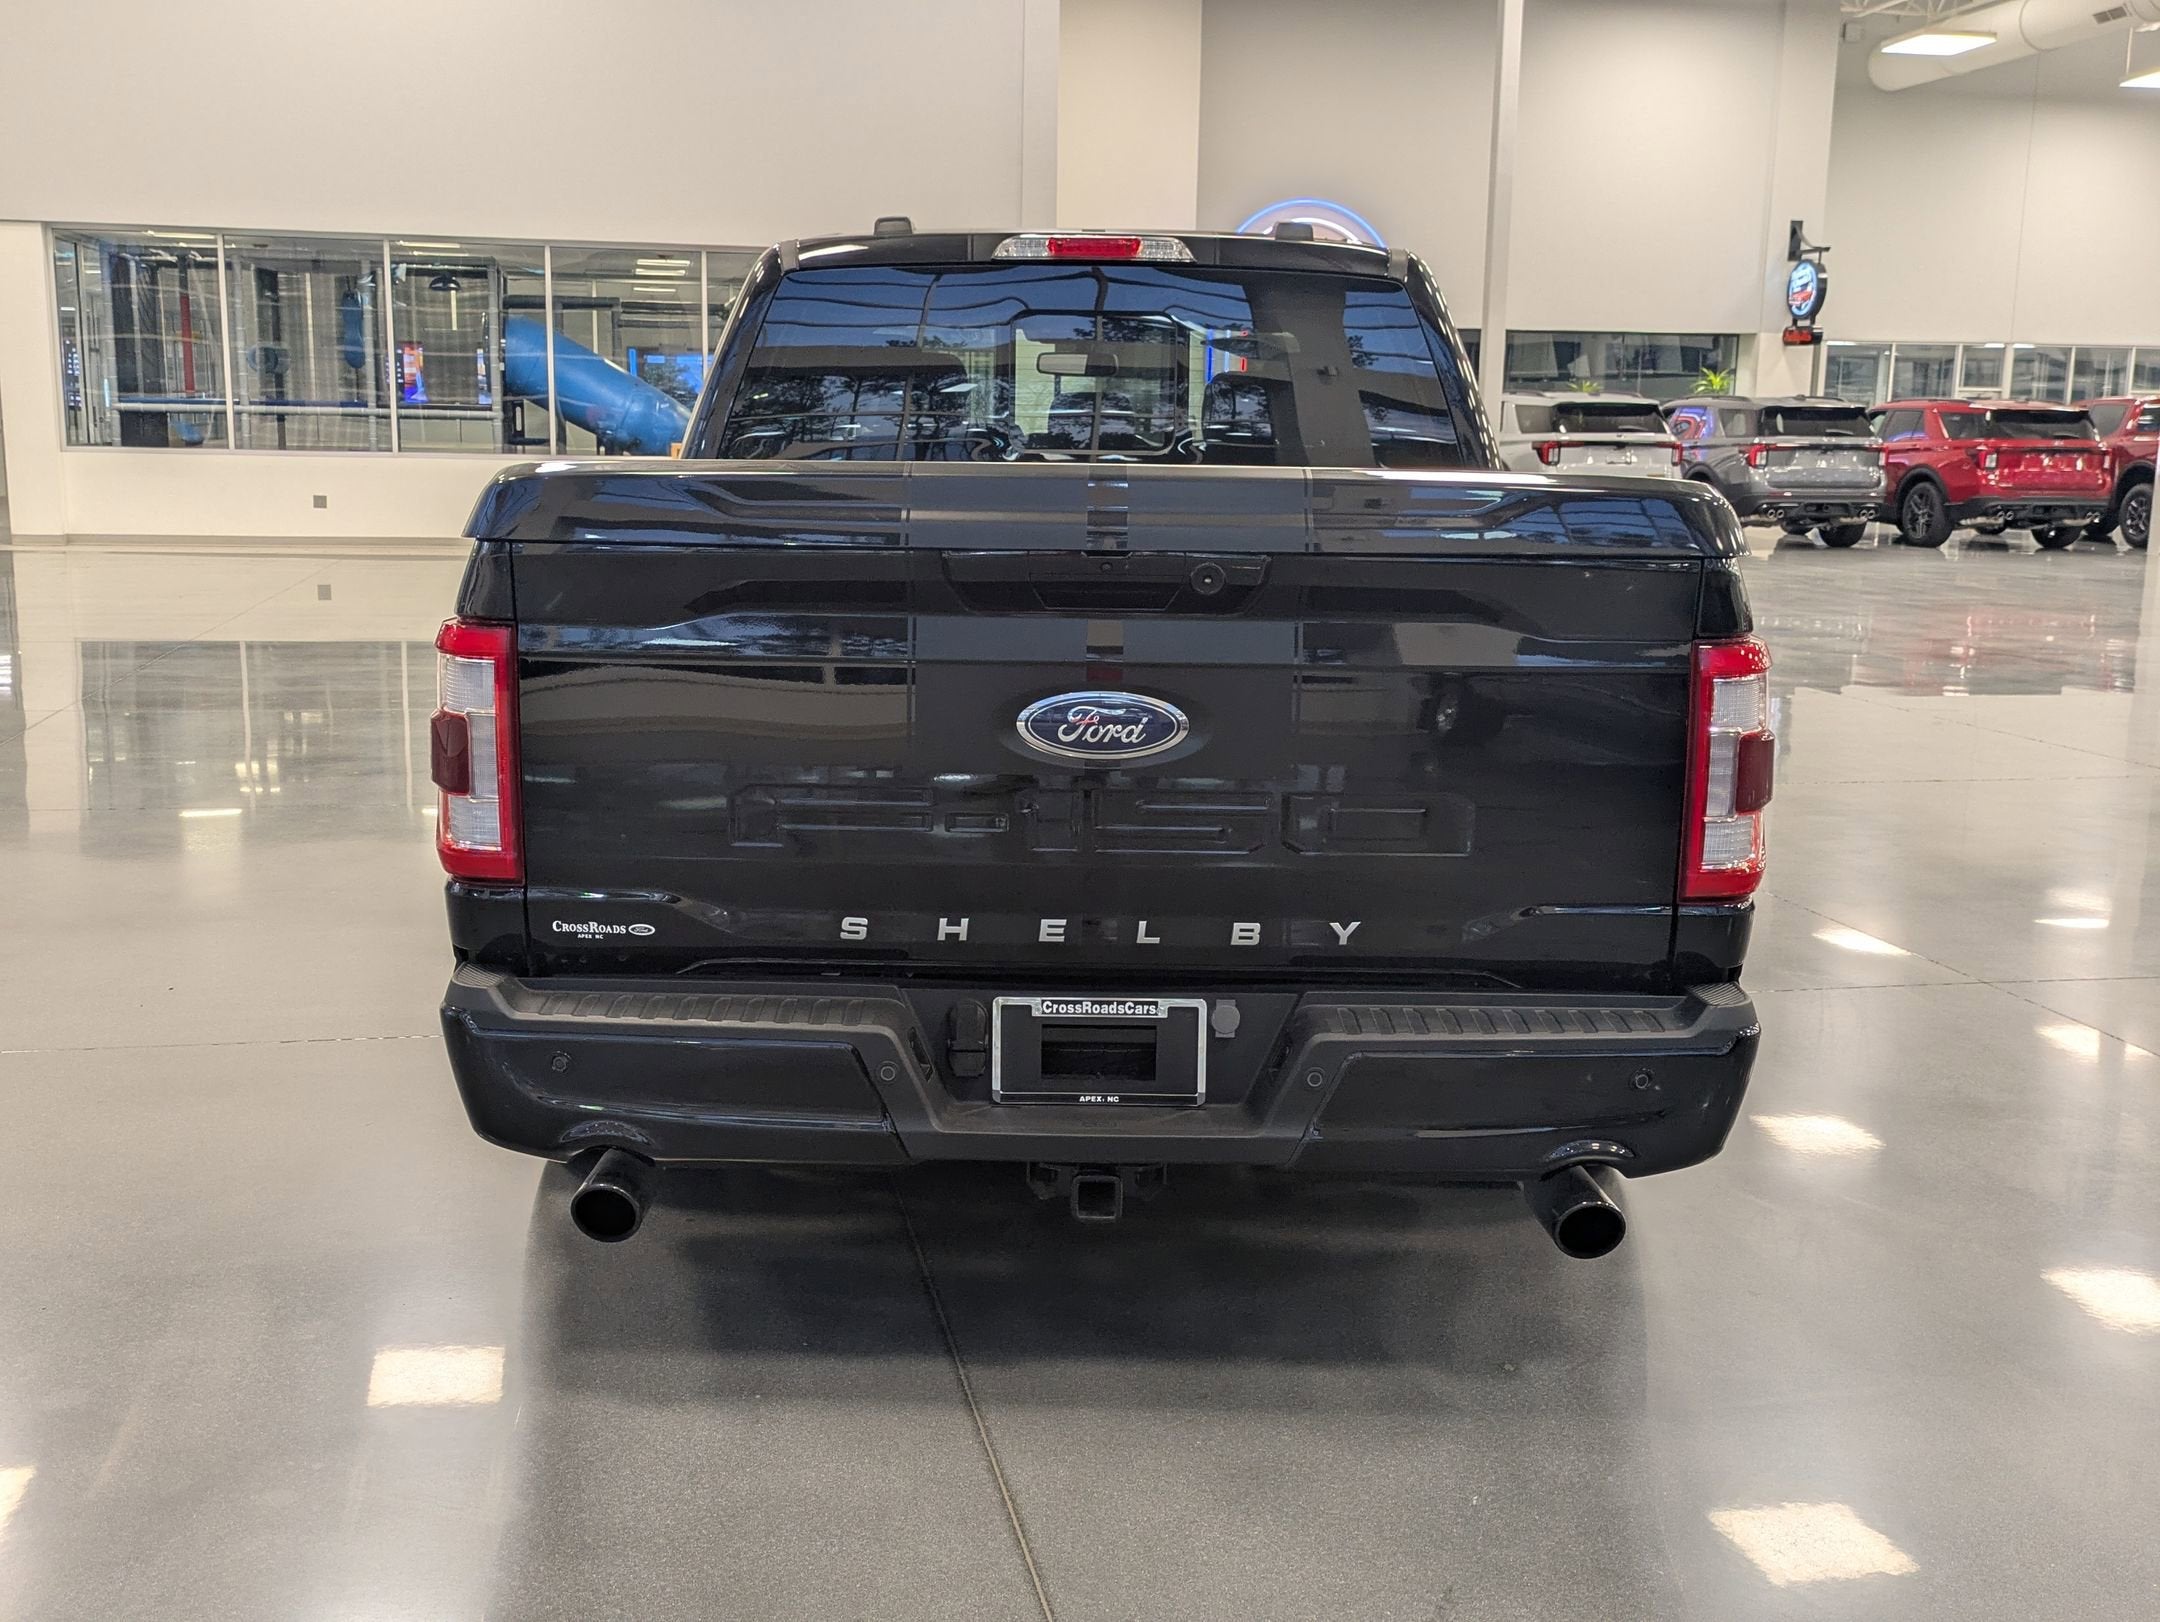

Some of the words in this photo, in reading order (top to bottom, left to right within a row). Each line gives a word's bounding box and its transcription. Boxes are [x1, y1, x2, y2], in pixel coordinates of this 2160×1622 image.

[1058, 705, 1148, 743] Ford
[840, 917, 1361, 946] SHELBY
[1042, 1001, 1156, 1015] CrossRoadsCars
[1106, 1095, 1120, 1103] NC
